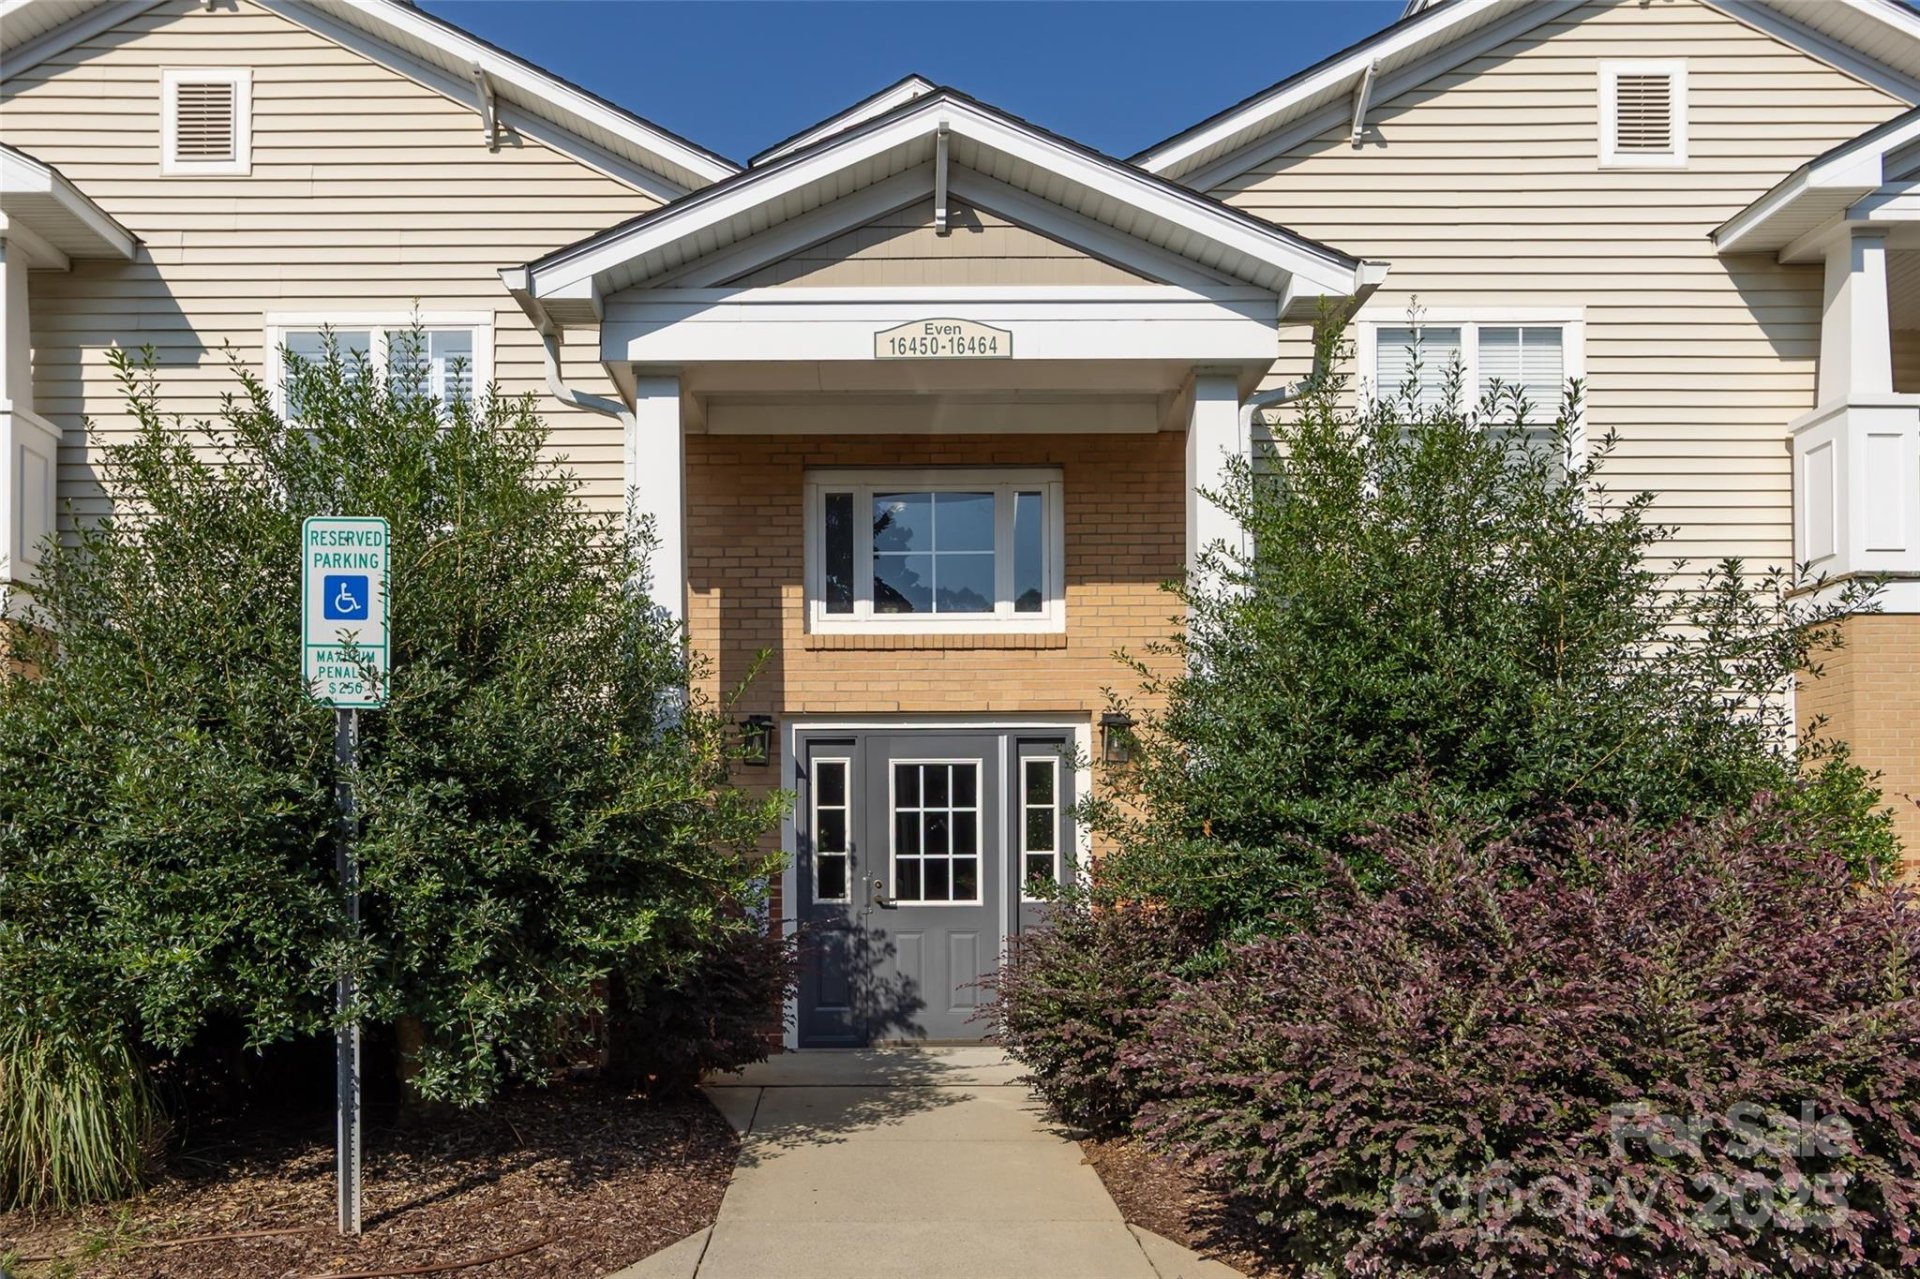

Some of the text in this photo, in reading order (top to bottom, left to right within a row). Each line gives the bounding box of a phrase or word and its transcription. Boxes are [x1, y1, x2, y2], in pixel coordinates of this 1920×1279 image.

[924, 323, 962, 335] Even
[889, 336, 998, 355] 16450-16464
[310, 530, 382, 547] RESERVED
[314, 553, 379, 569] PARKING
[316, 650, 375, 663] MAXUM
[318, 666, 376, 679] PENAL
[328, 682, 363, 695] $250
